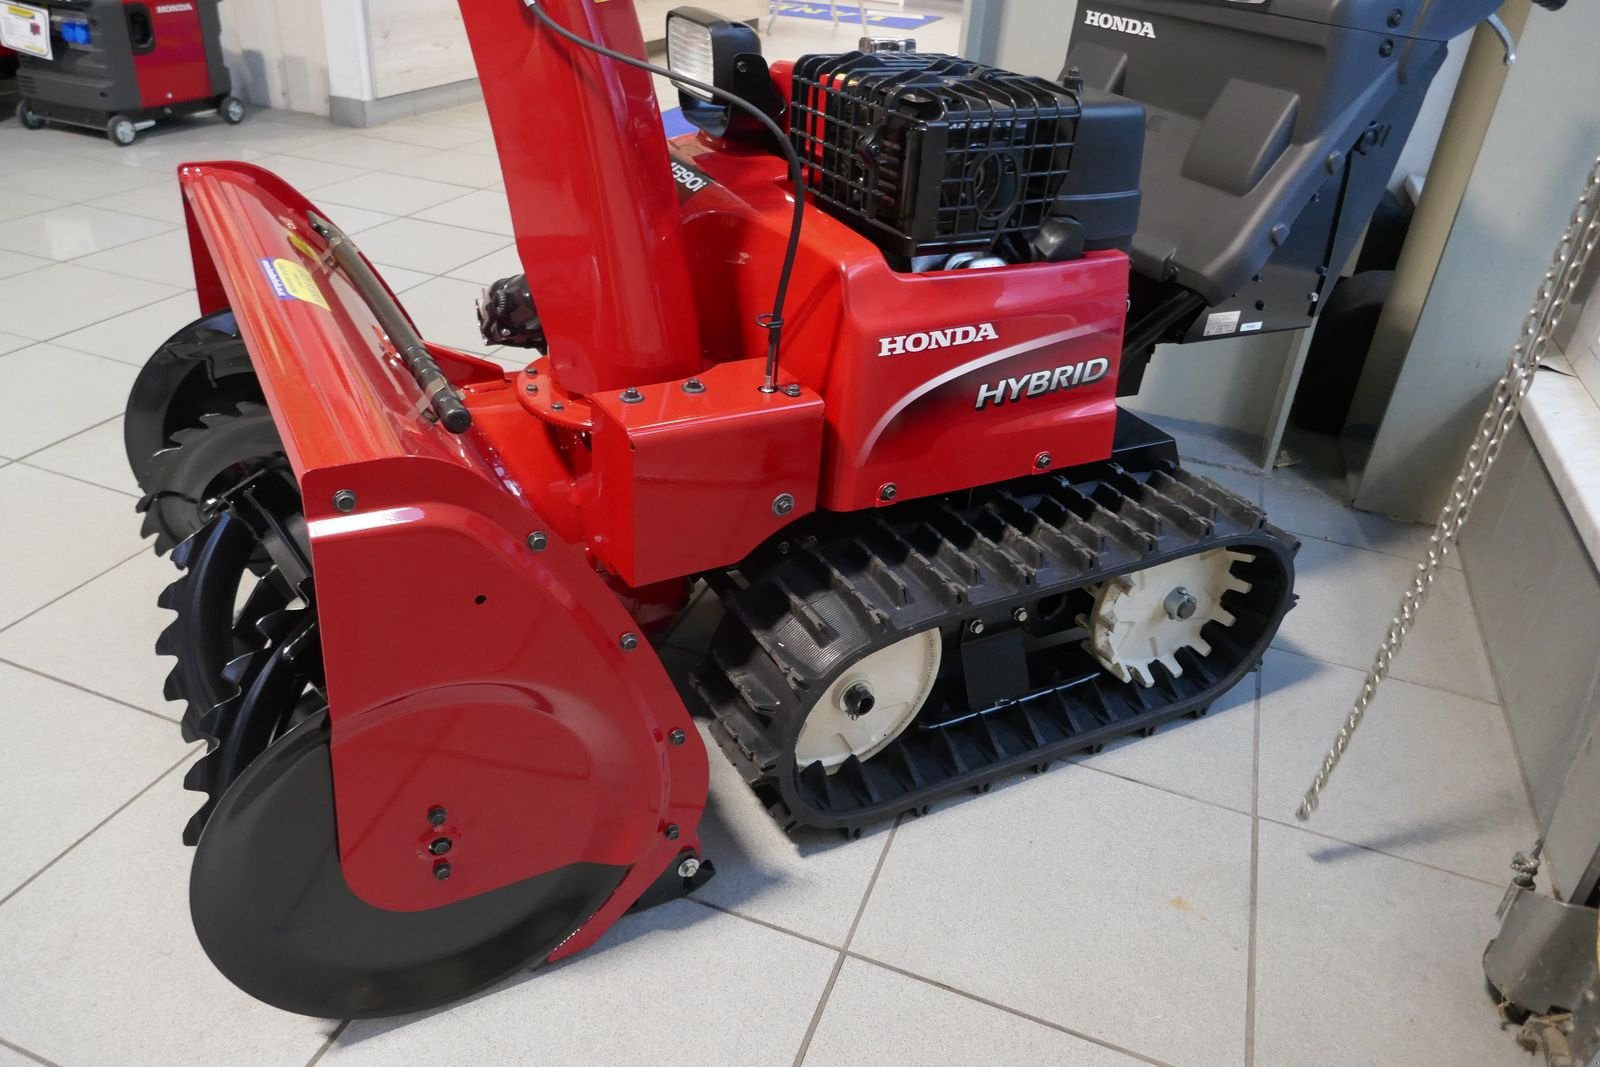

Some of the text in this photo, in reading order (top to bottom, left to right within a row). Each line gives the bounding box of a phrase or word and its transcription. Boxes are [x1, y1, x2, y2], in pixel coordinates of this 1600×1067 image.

[156, 3, 193, 14] HONDA
[1084, 10, 1156, 39] HONDA
[671, 161, 708, 192] 1390i
[878, 322, 999, 357] HONDA
[975, 357, 1110, 409] HYBRID
